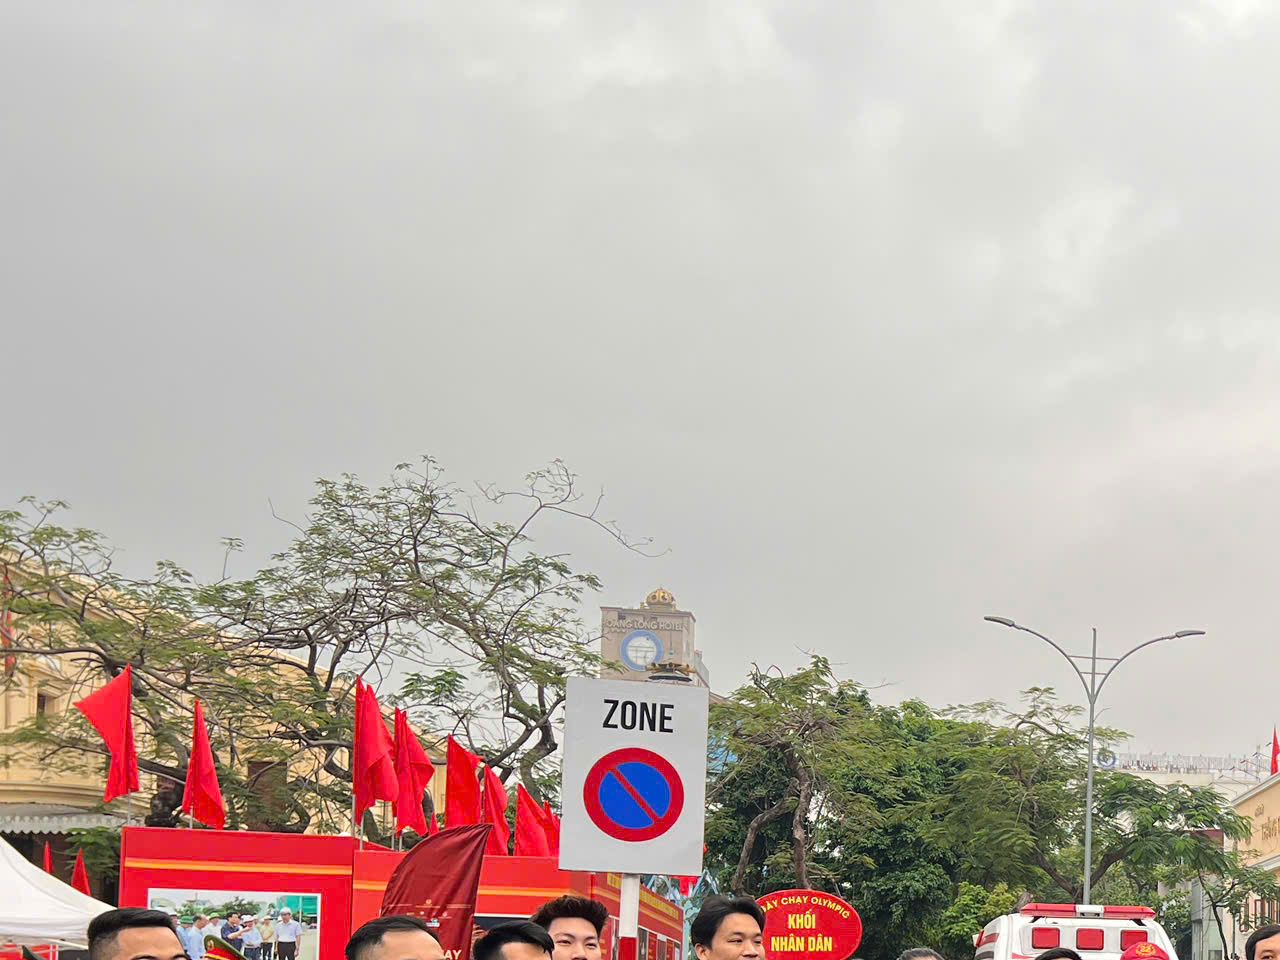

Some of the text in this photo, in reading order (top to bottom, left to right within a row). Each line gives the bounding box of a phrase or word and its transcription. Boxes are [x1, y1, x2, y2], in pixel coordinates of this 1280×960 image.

[634, 620, 657, 629] LONG
[602, 699, 674, 733] ZONE
[781, 896, 808, 905] CHẠY
[811, 897, 851, 918] OLYMPIC
[788, 908, 816, 928] KHỐI
[771, 933, 832, 951] NHÂN DÂN
